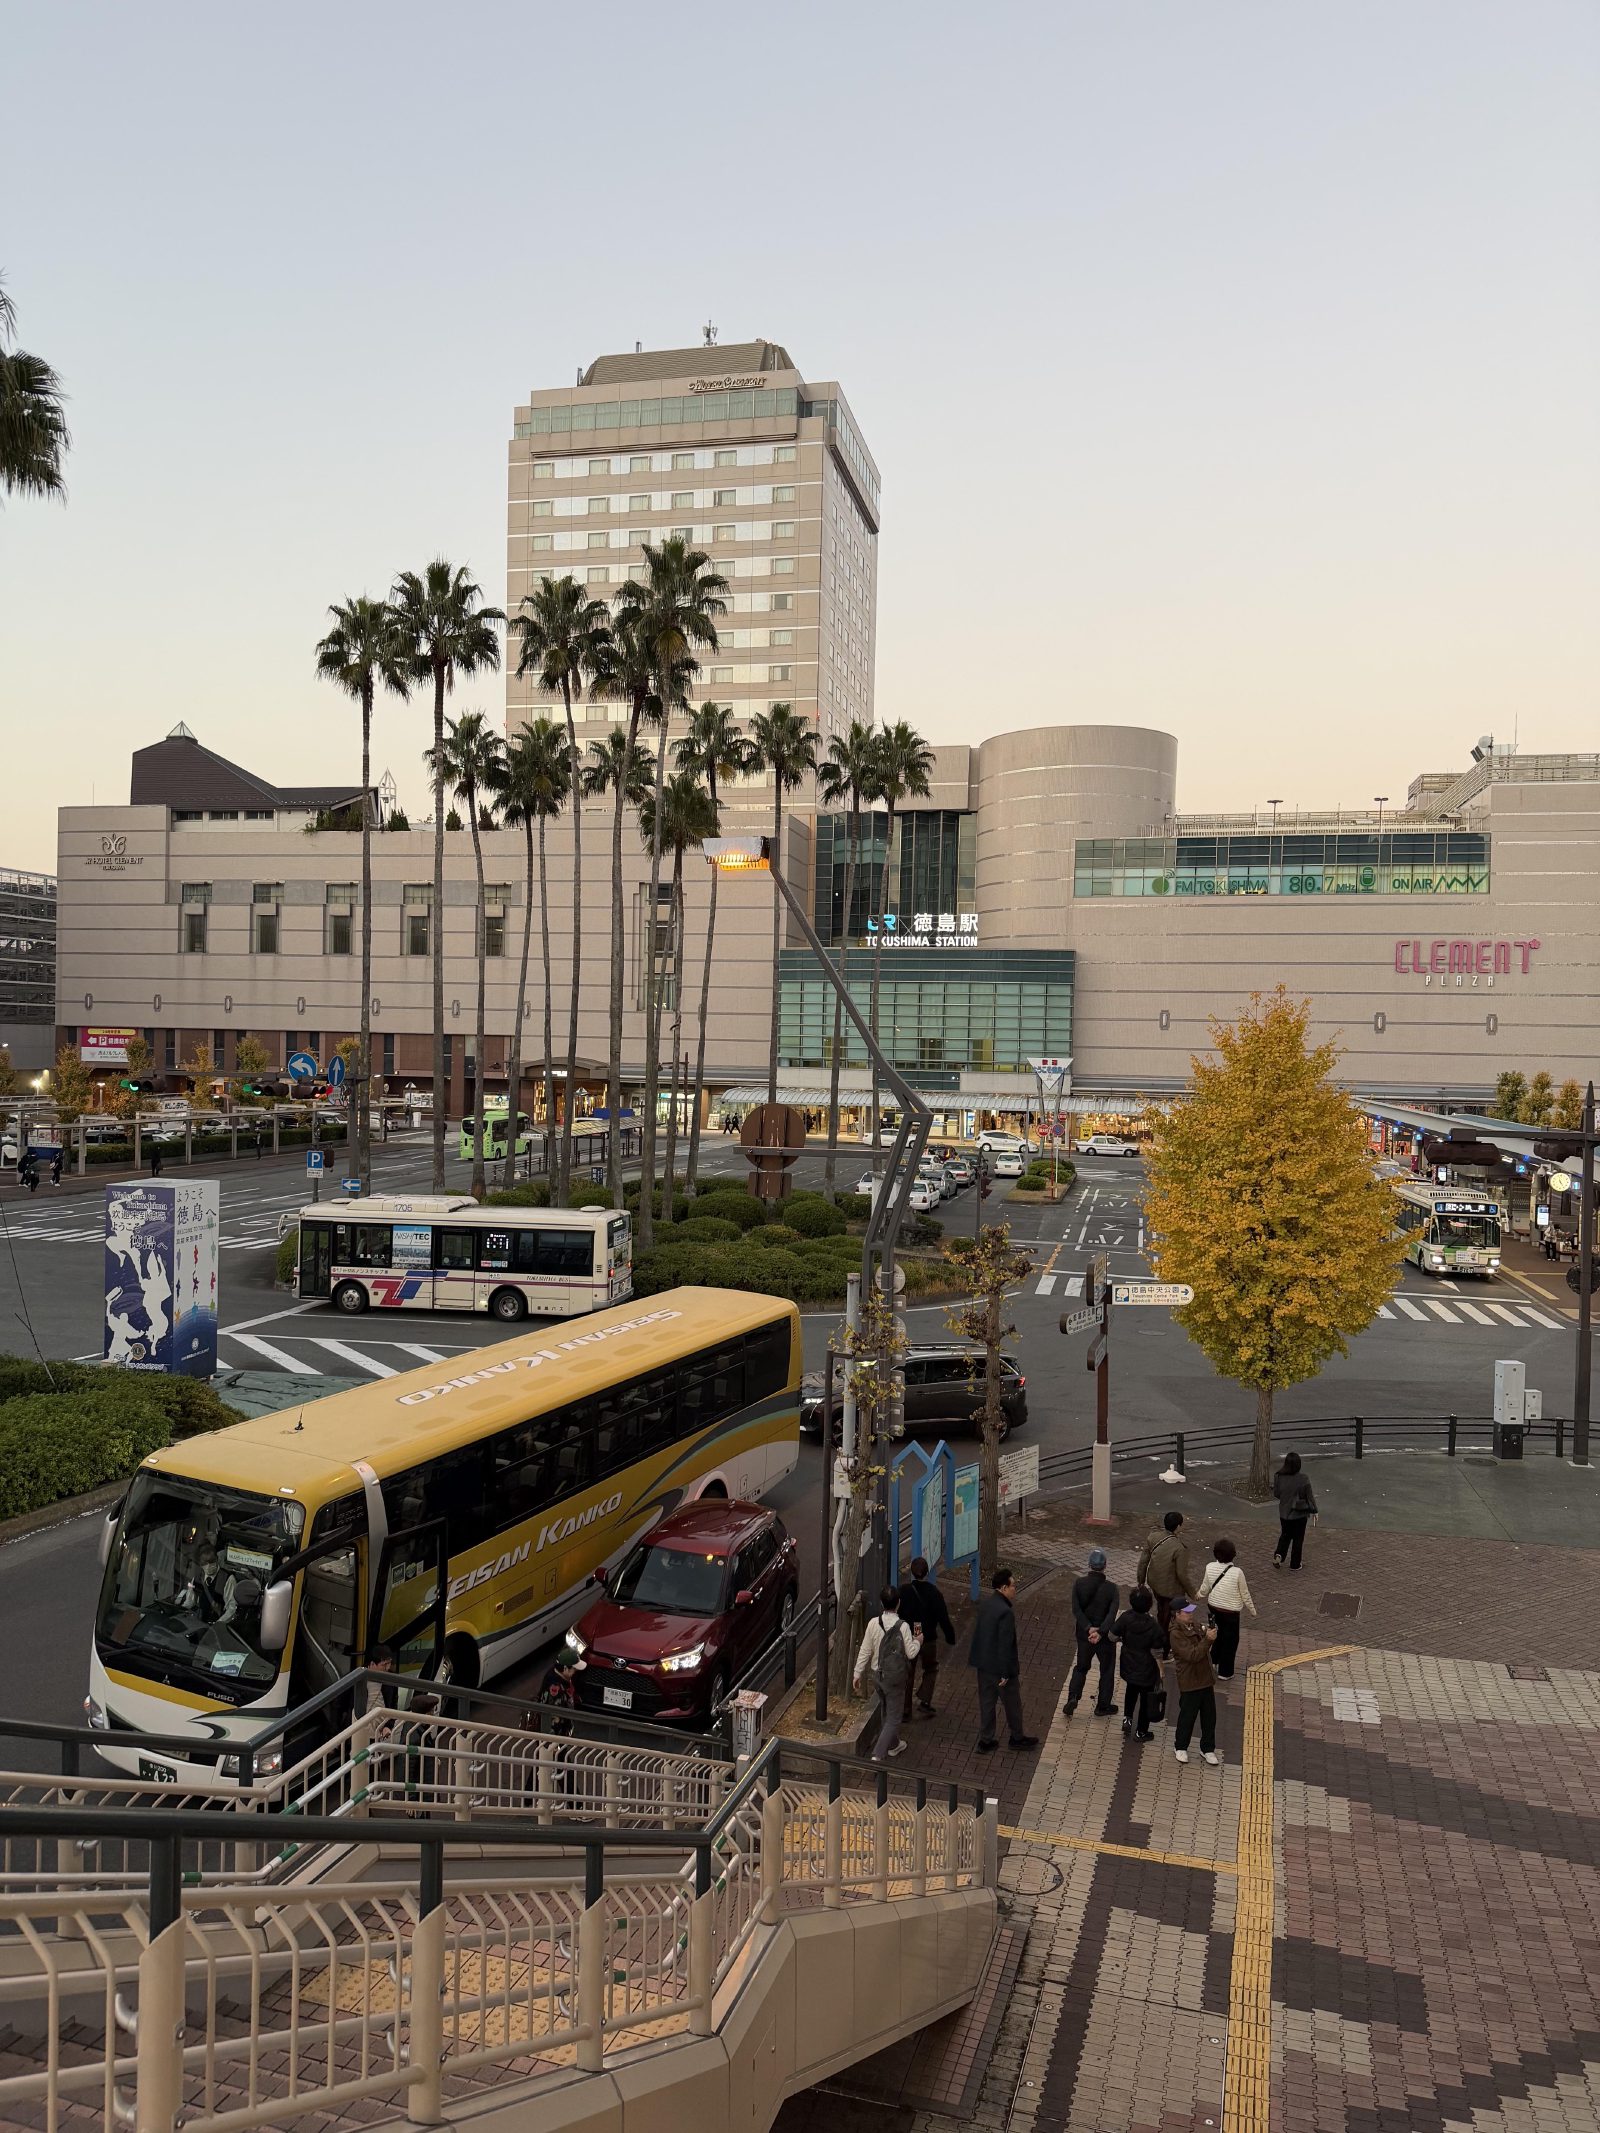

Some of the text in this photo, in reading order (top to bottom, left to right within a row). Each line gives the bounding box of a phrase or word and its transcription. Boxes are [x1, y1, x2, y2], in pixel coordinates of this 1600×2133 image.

[1176, 881, 1193, 892] FM
[1196, 880, 1268, 892] TOKUSHIMA
[1393, 879, 1409, 889] ON
[1414, 879, 1432, 889] AIR
[914, 913, 978, 932] 徳島駅
[935, 936, 977, 946] STATION
[1395, 940, 1529, 973] CLEMENT
[1425, 976, 1494, 986] PLAZA
[311, 1152, 320, 1167] P
[177, 1188, 204, 1202] ようこそ
[177, 1203, 217, 1226] 徳島へ
[1131, 1286, 1180, 1294] 徳島中央公園
[536, 1492, 623, 1553] KANKO
[207, 1691, 235, 1703] FUSO
[622, 1697, 631, 1707] 30
